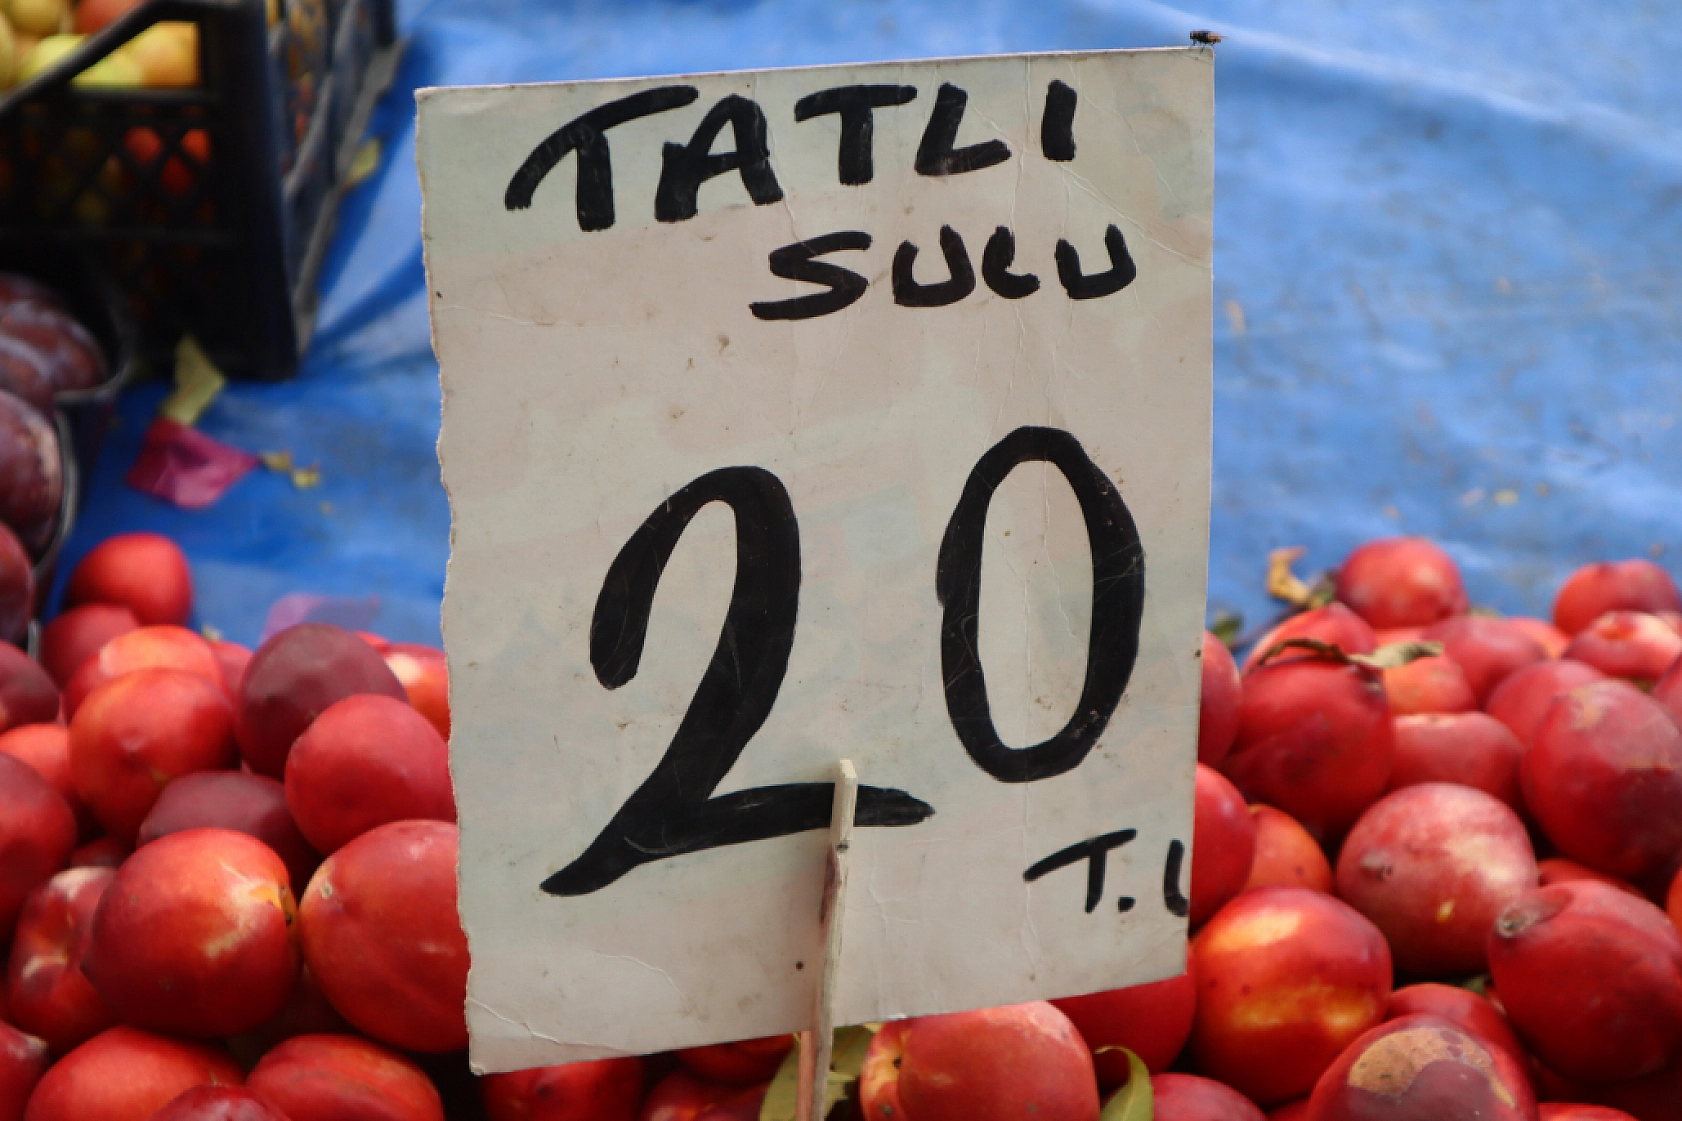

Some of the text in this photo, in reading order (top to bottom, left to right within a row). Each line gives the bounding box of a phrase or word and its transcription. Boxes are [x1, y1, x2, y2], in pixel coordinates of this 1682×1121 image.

[505, 80, 1078, 232] TATLI
[749, 223, 1137, 321] SULU
[539, 425, 1145, 898] 20
